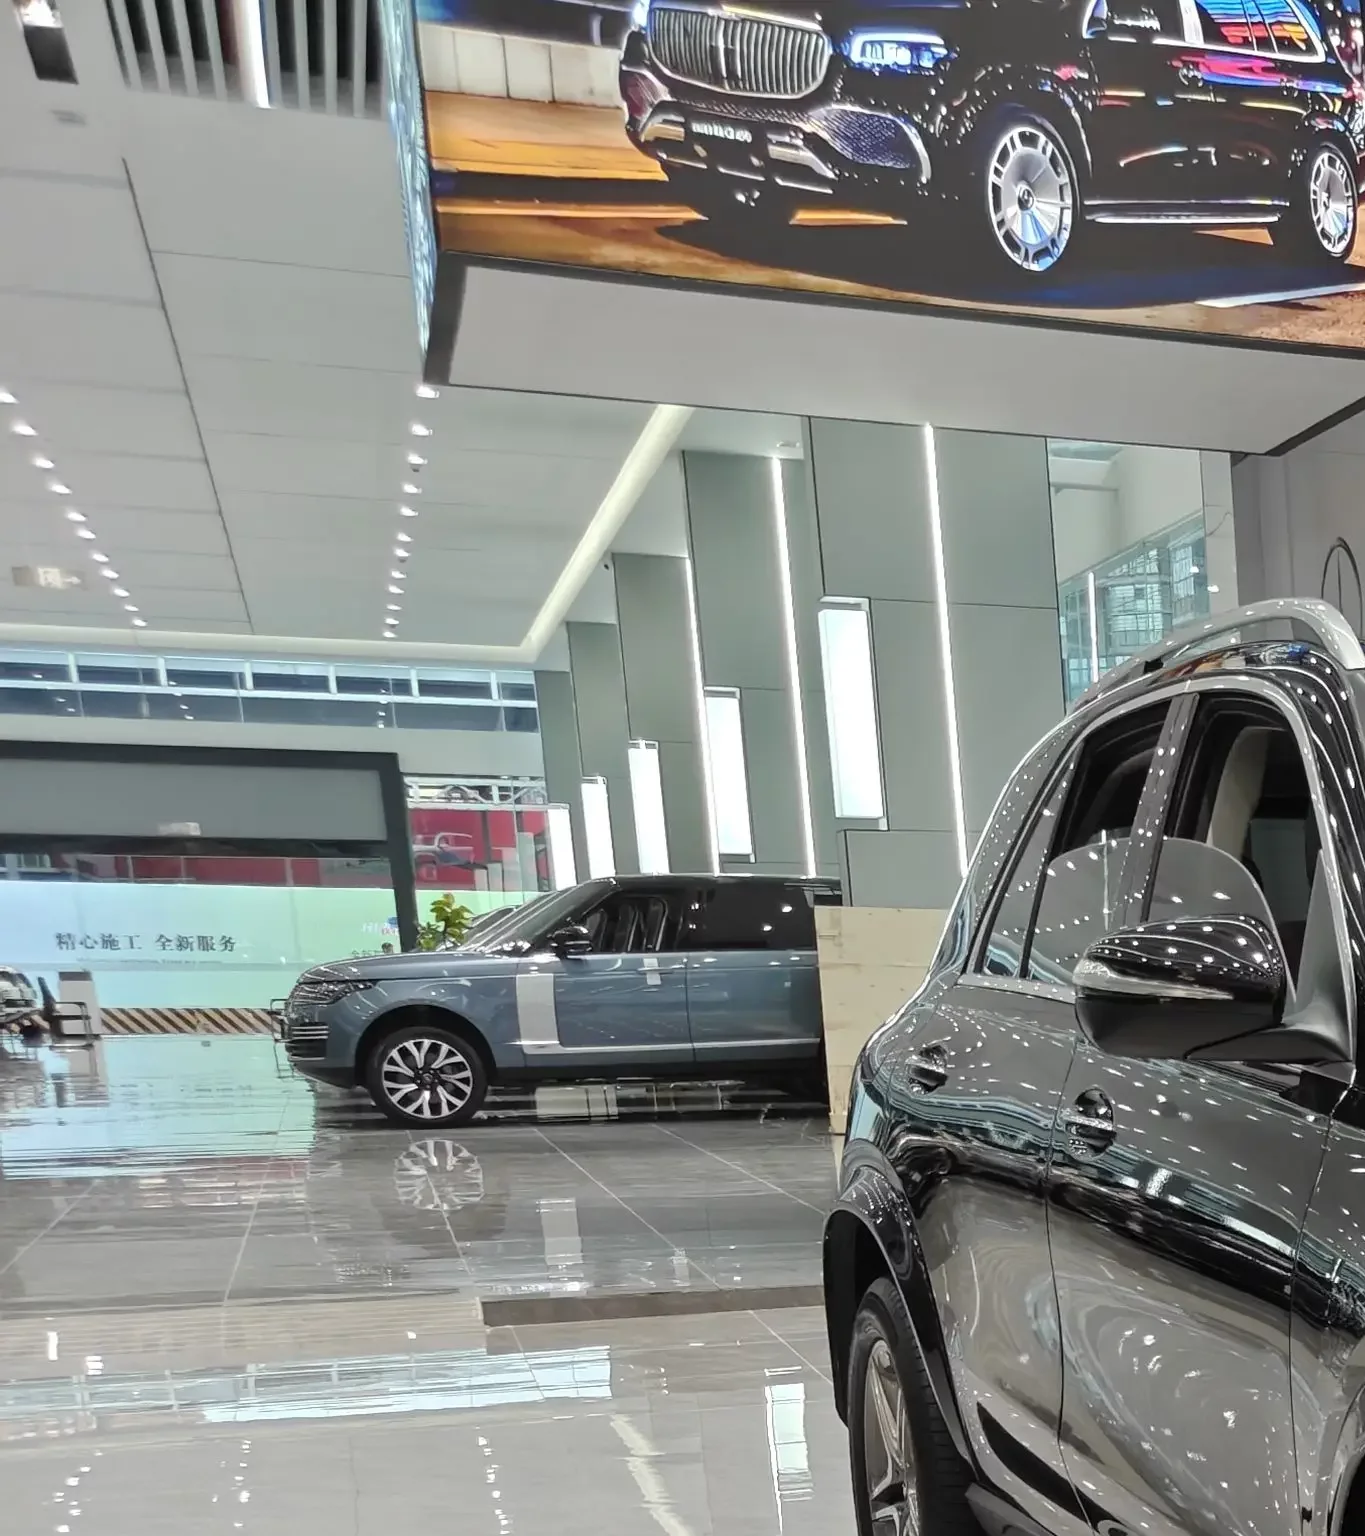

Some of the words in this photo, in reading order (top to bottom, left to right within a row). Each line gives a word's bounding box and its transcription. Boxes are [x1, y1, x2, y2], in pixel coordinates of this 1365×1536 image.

[55, 932, 142, 951] 精心施工
[155, 933, 237, 953] 全新服务
